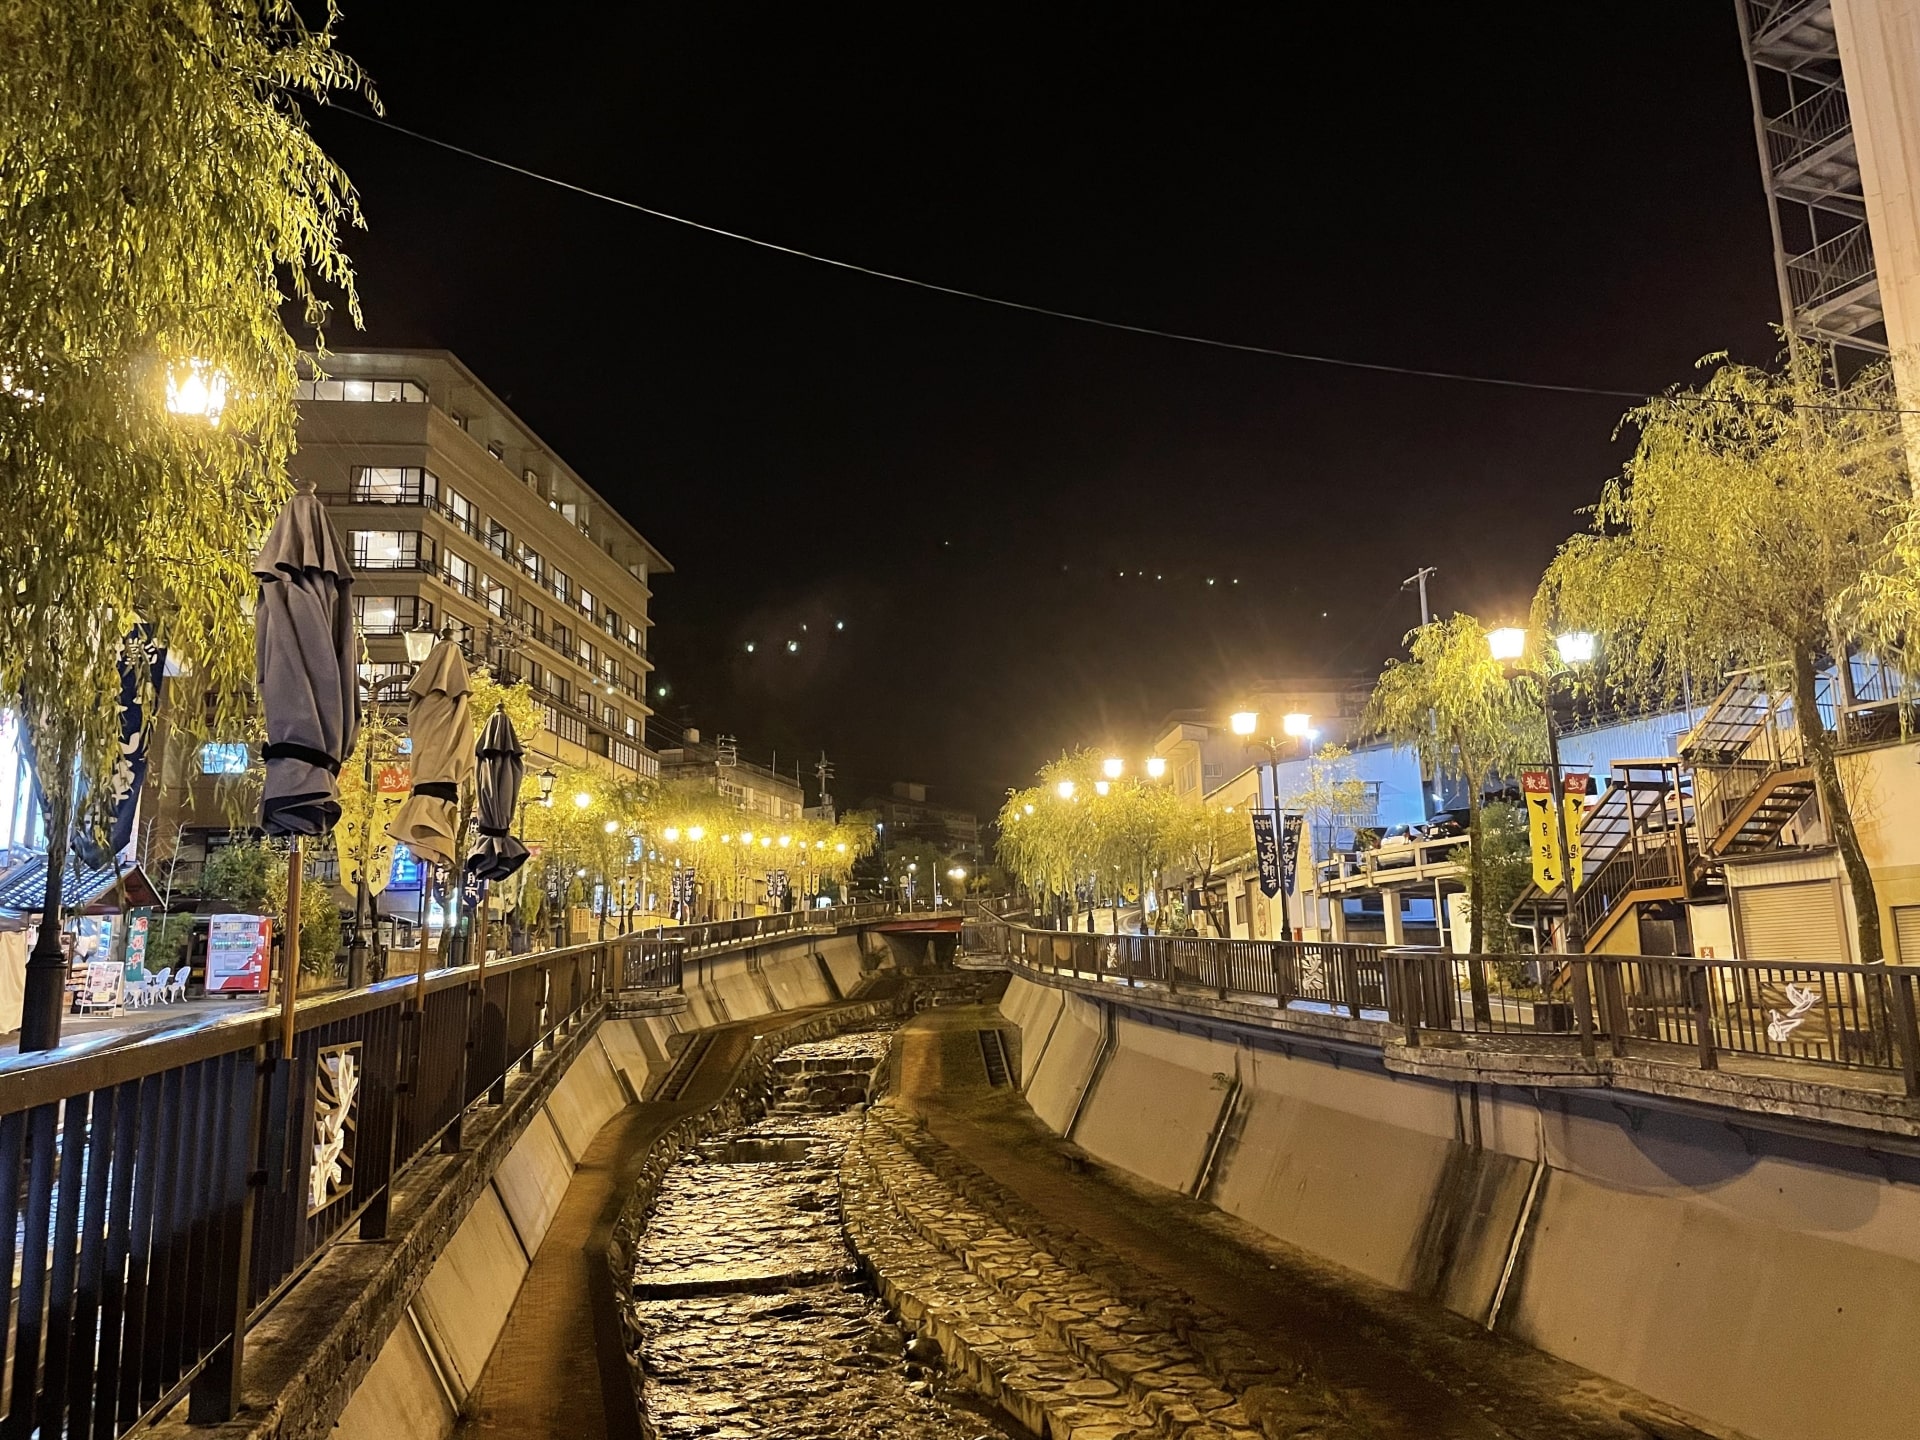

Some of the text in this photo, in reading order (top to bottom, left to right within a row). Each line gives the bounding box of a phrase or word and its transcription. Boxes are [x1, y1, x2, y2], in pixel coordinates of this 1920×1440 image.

[1525, 776, 1549, 790] 歓迎
[1257, 834, 1278, 889] いでゆ朝市
